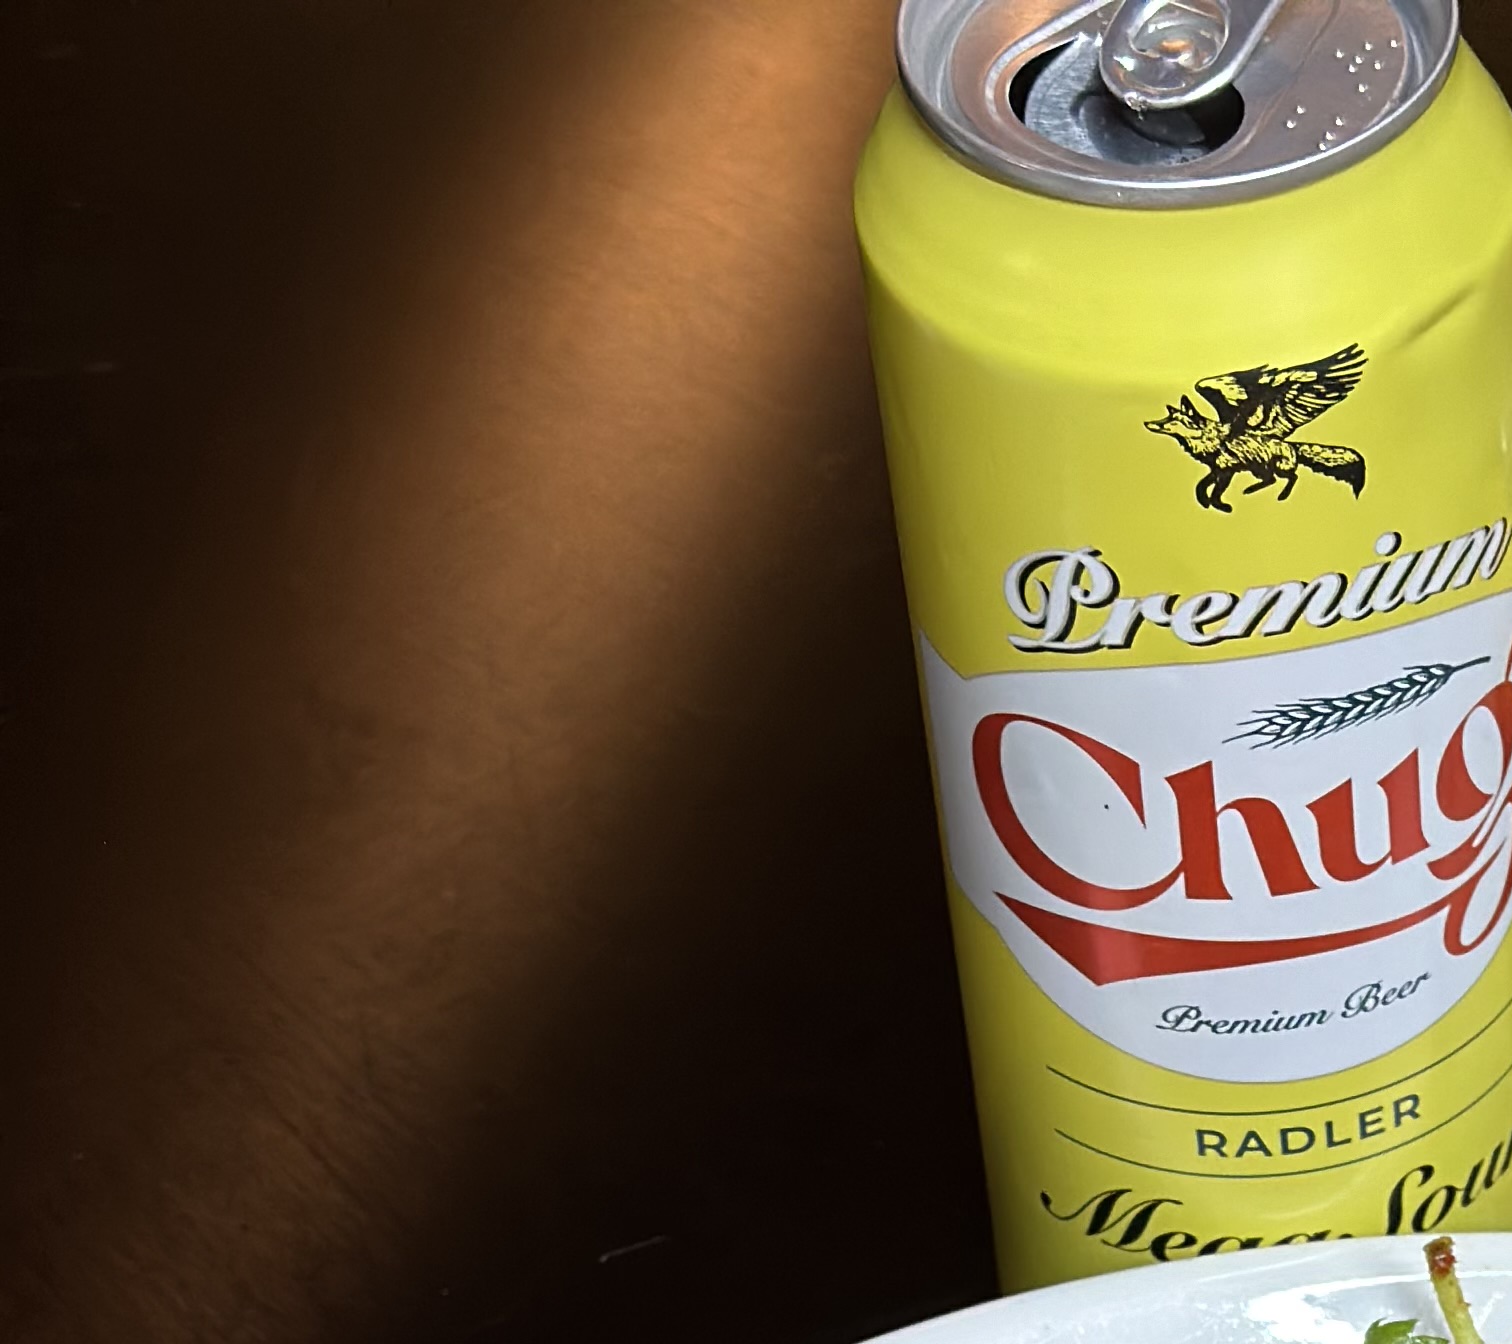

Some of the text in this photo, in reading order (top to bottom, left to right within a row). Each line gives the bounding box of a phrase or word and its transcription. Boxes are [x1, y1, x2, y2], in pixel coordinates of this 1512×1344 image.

[1156, 971, 1432, 1035] Premium Beer
[1196, 1093, 1421, 1158] RADLER
